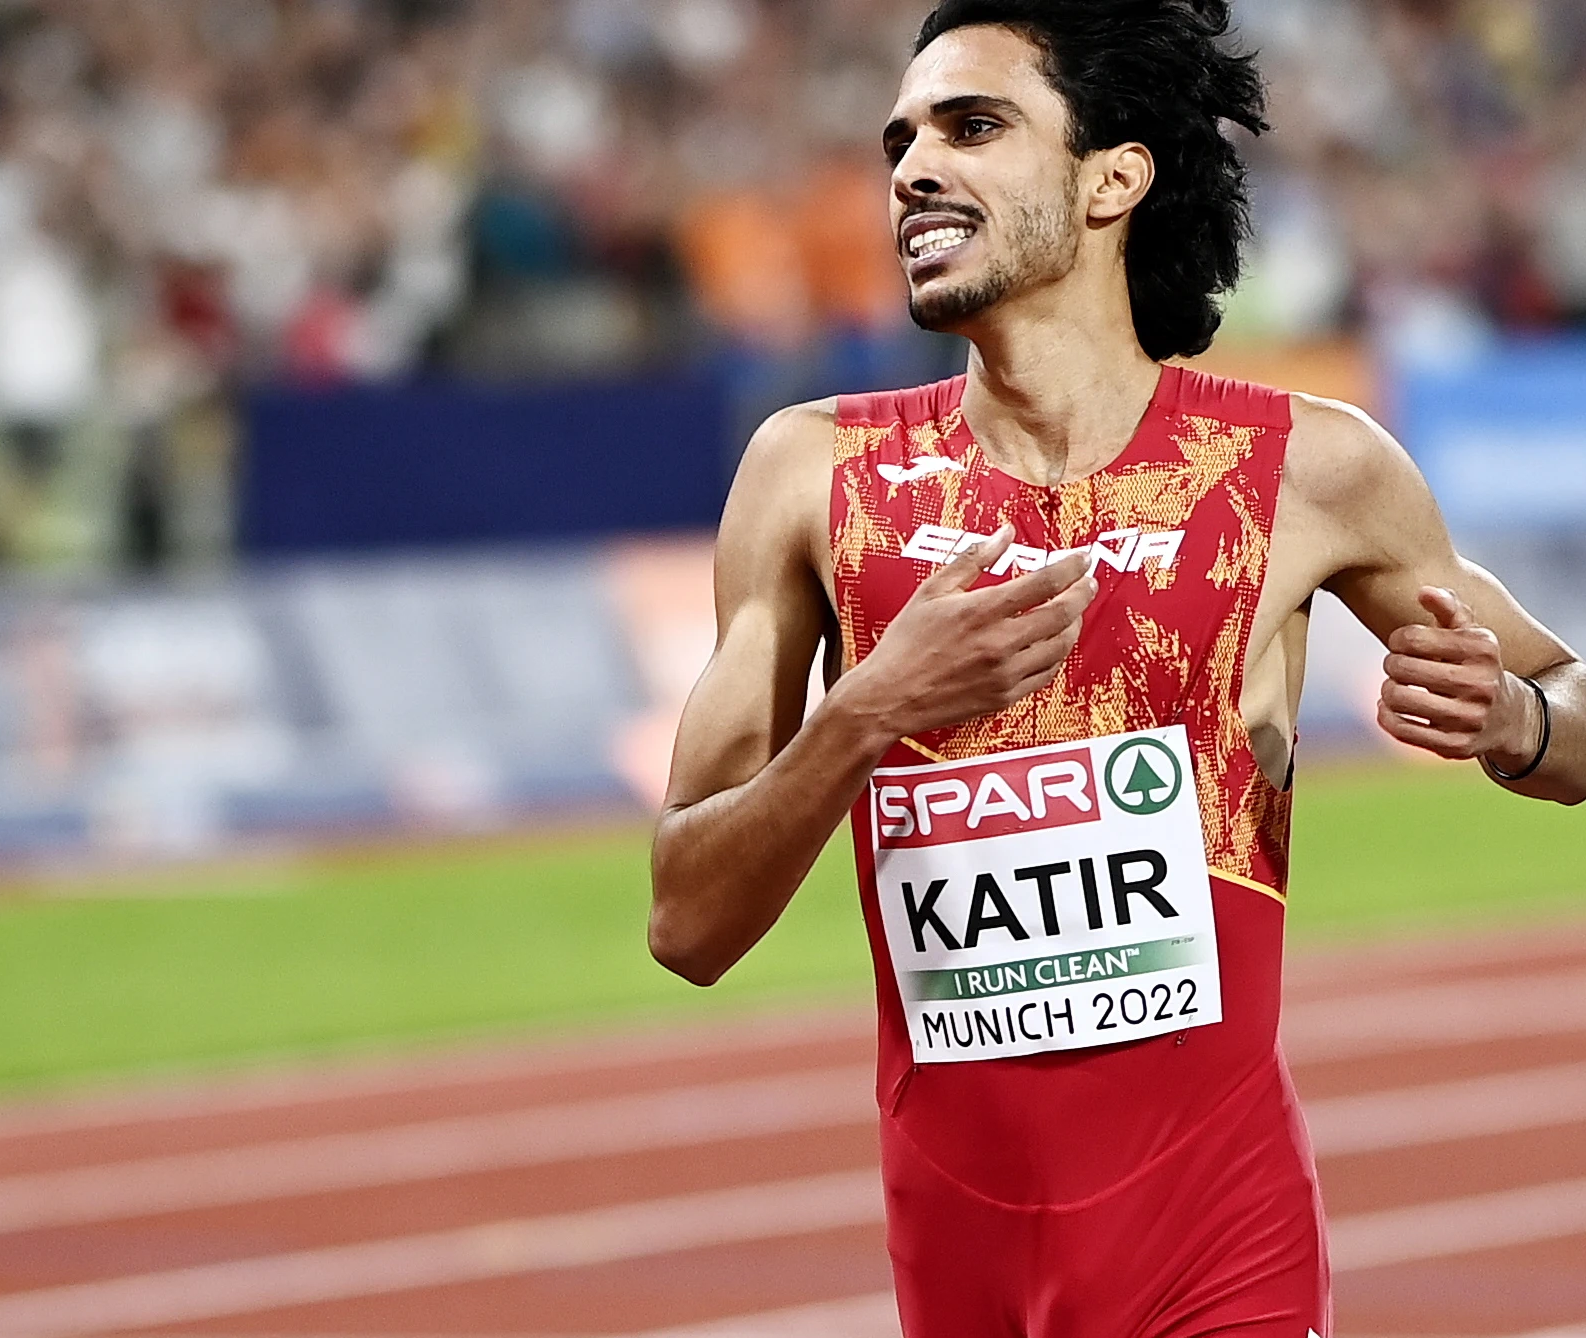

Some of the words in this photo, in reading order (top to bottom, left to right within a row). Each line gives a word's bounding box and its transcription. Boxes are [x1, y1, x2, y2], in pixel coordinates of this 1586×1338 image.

[879, 759, 1092, 838] SPAR
[902, 848, 1180, 953] KATIR
[921, 998, 1075, 1049] MUNICH
[1092, 978, 1199, 1031] 2022
[952, 972, 964, 997] I
[967, 964, 1028, 996] RUN
